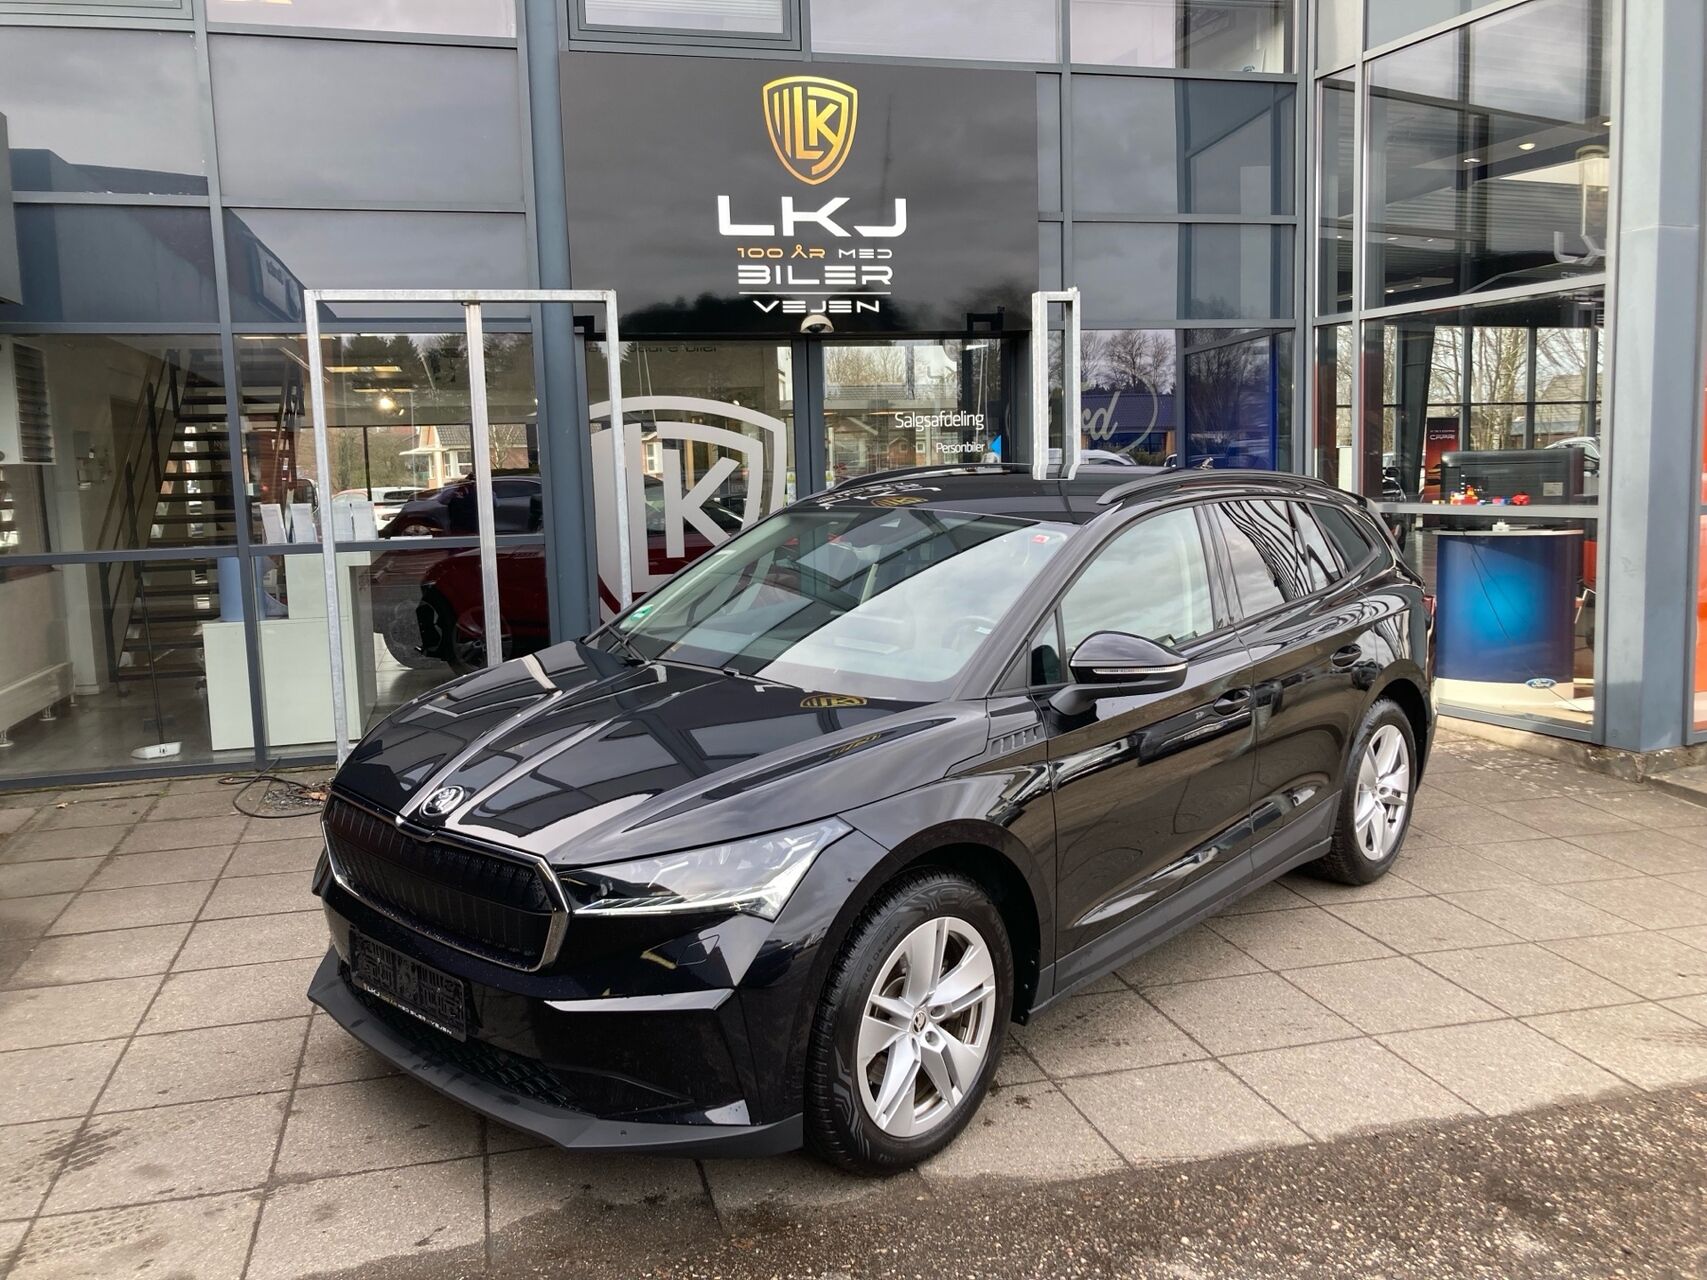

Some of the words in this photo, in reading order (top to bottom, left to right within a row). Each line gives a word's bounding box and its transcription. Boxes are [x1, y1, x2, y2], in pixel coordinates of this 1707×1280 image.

[717, 194, 908, 238] LKJ
[737, 247, 784, 260] 100
[791, 244, 826, 260] ÅR
[838, 248, 893, 259] MED
[737, 264, 894, 286] BILER
[752, 300, 880, 314] VEJEN
[894, 410, 985, 432] Salgsafdeling
[936, 441, 985, 454] Personbiler
